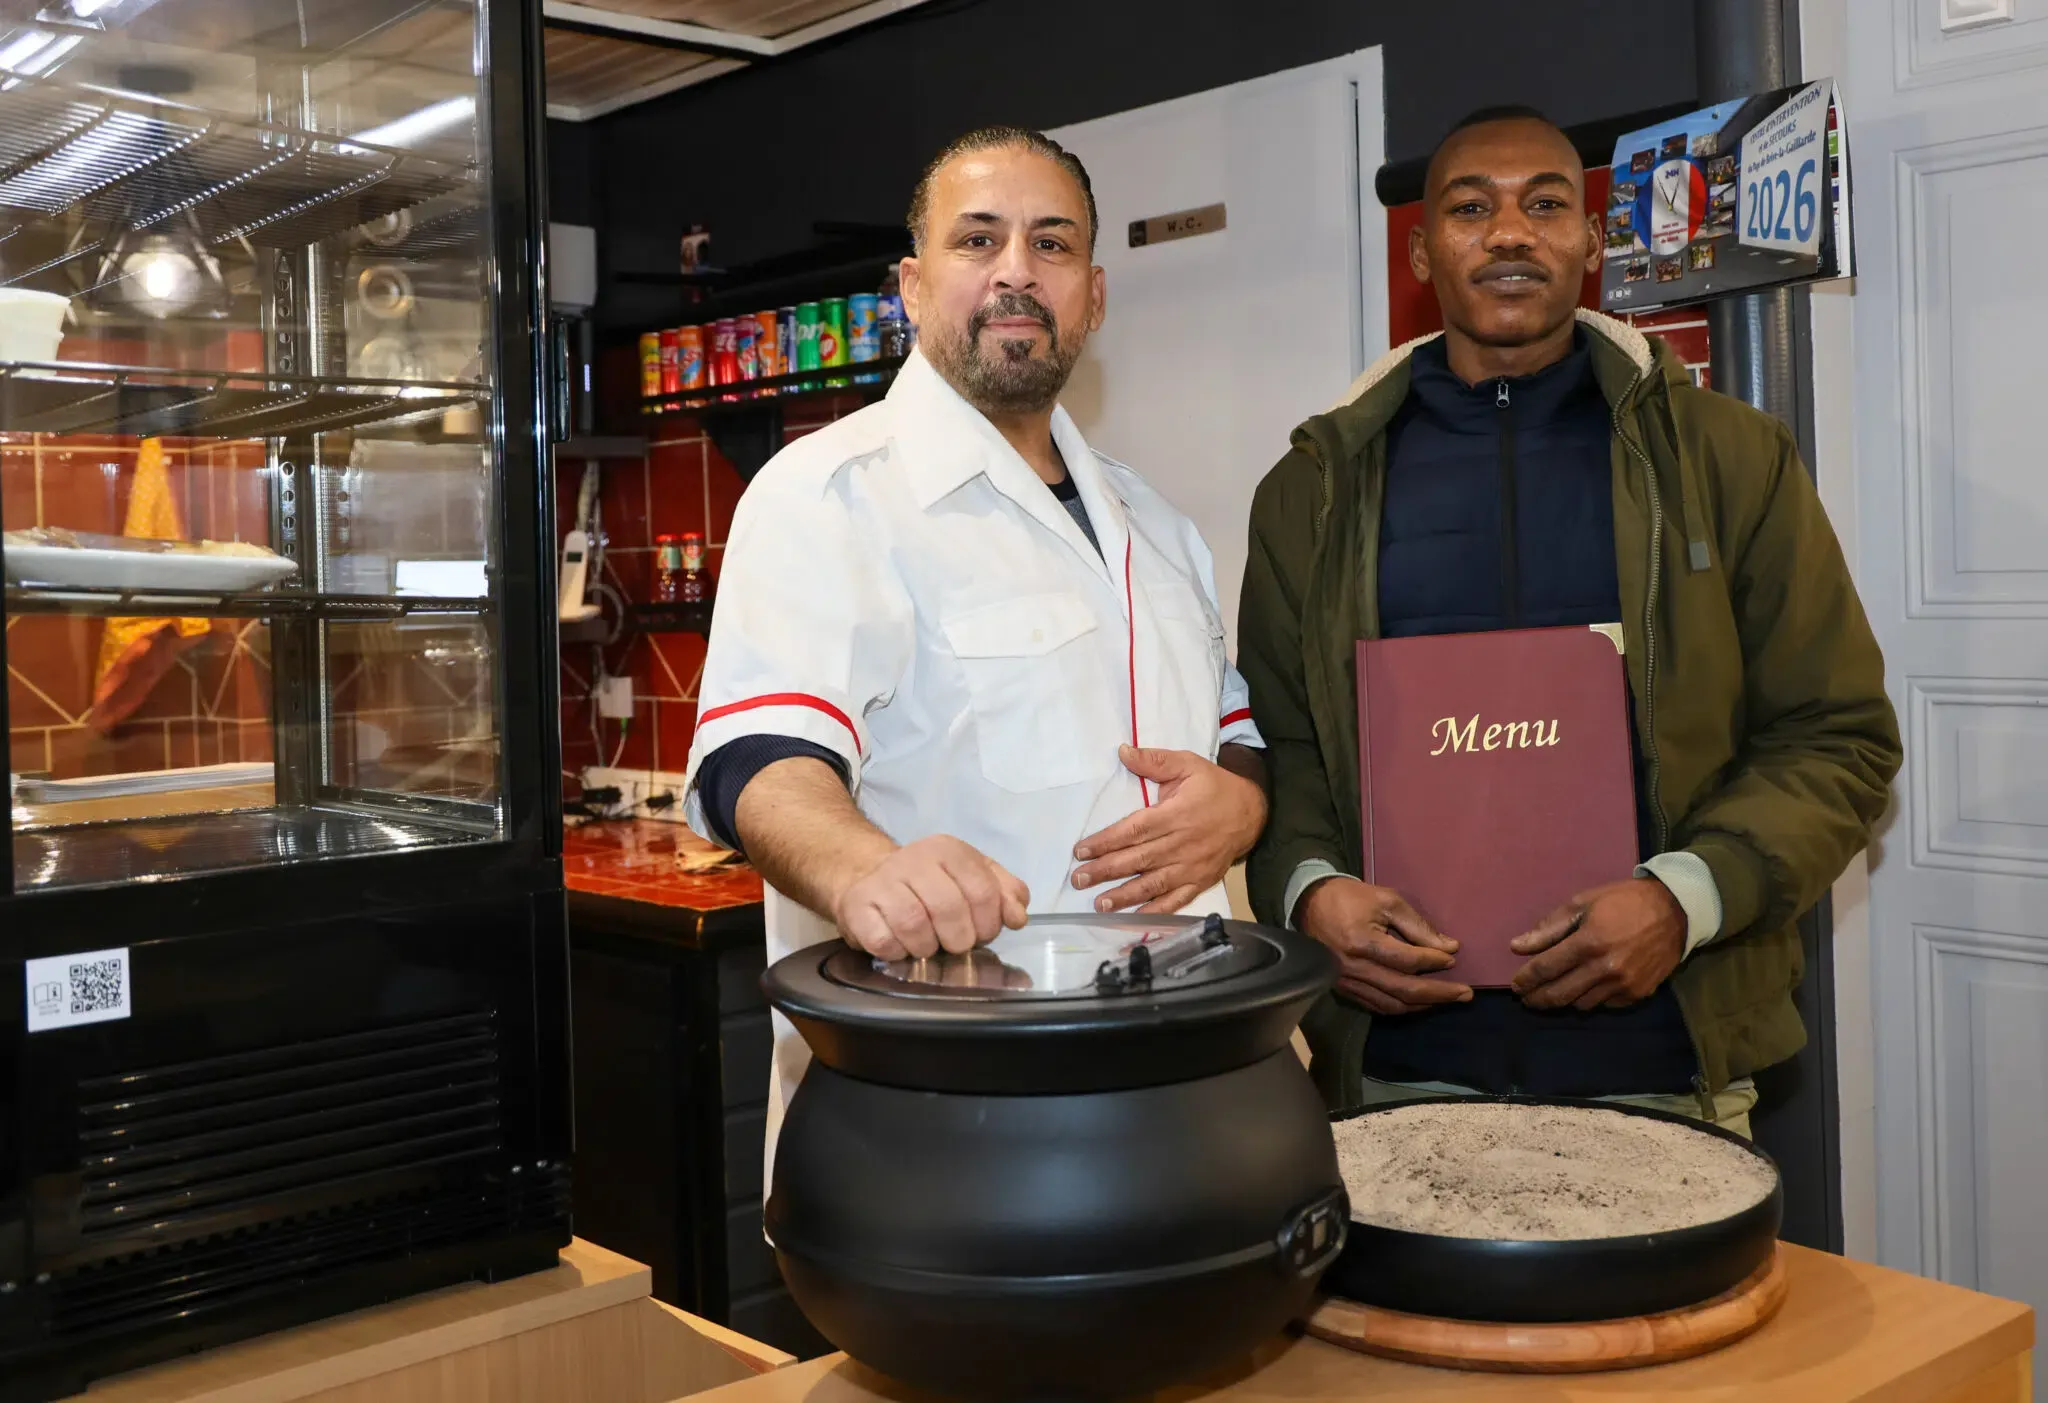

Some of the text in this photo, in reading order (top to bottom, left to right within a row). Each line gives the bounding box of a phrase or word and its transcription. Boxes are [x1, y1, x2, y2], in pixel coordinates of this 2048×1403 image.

[1769, 119, 1797, 147] SECOURS
[1747, 159, 1816, 243] 2026
[1167, 216, 1203, 233] W.C.
[1430, 713, 1561, 756] Menu
